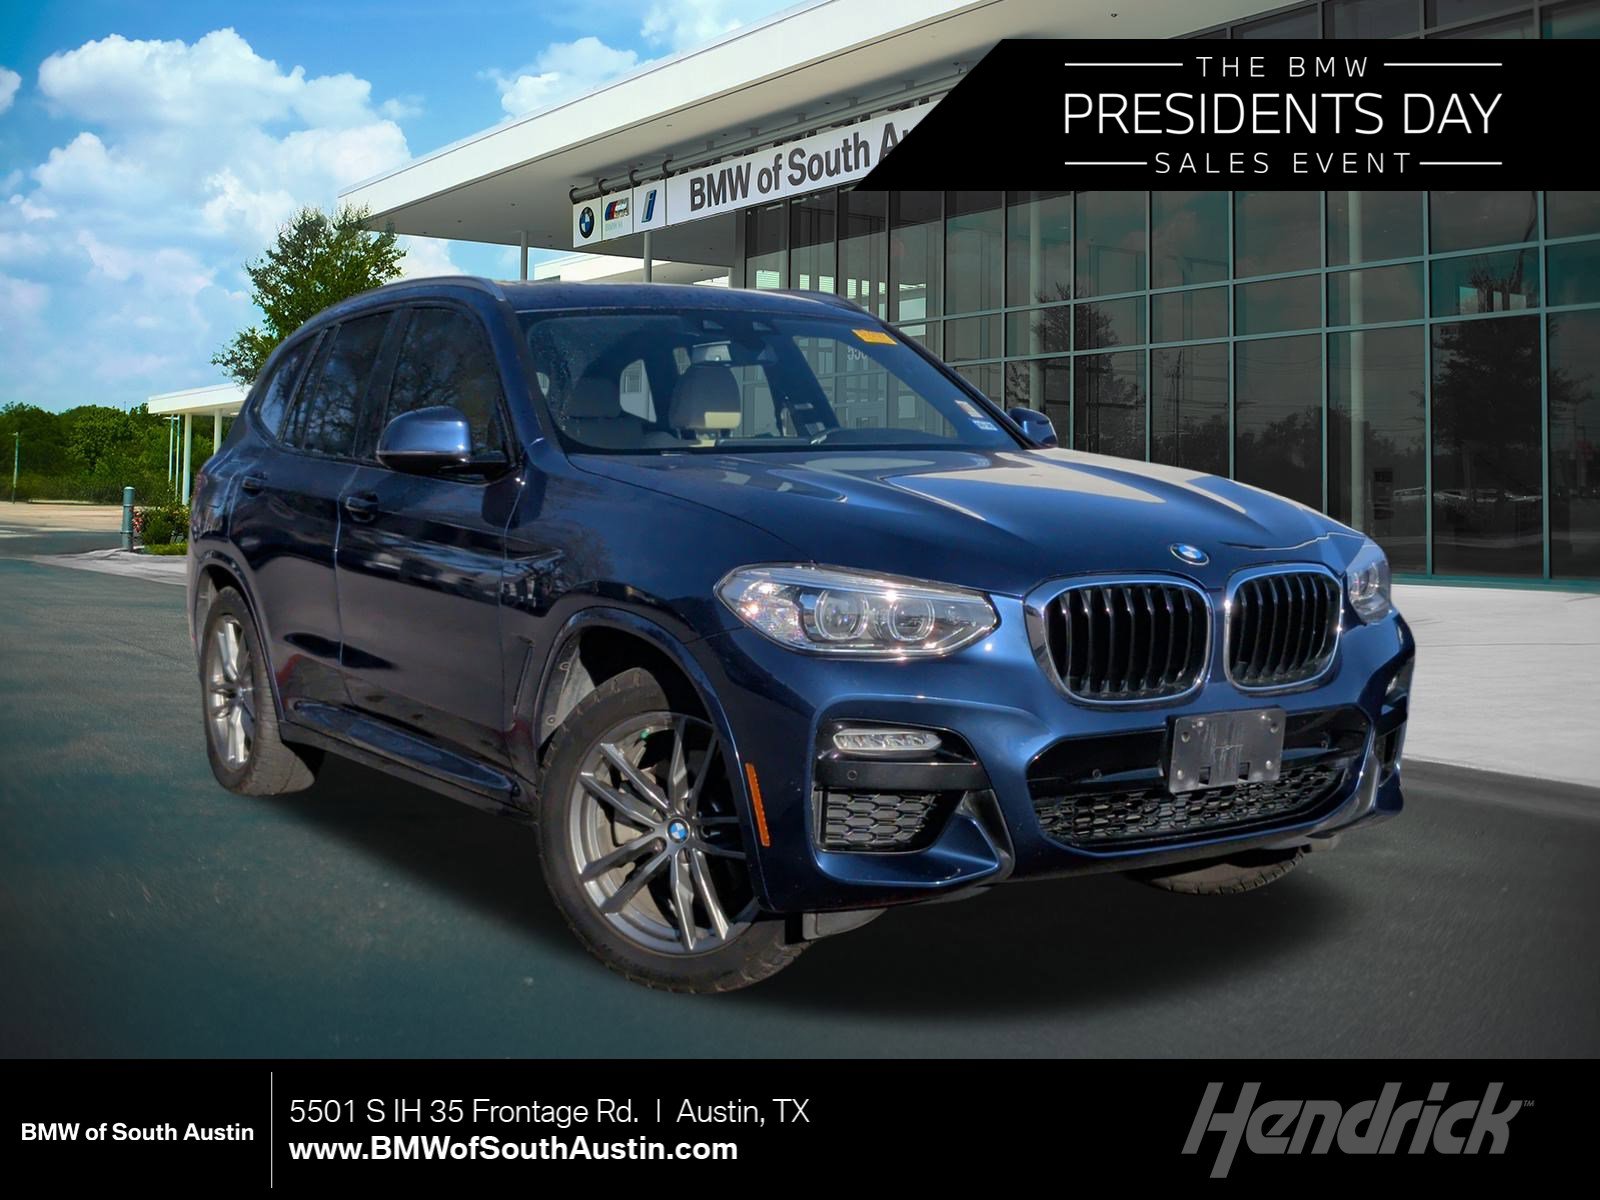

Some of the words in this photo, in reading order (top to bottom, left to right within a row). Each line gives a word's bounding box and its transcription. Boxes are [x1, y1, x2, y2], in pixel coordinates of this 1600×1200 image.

[689, 163, 751, 211] BMW
[757, 153, 782, 194] of
[787, 132, 870, 186] South
